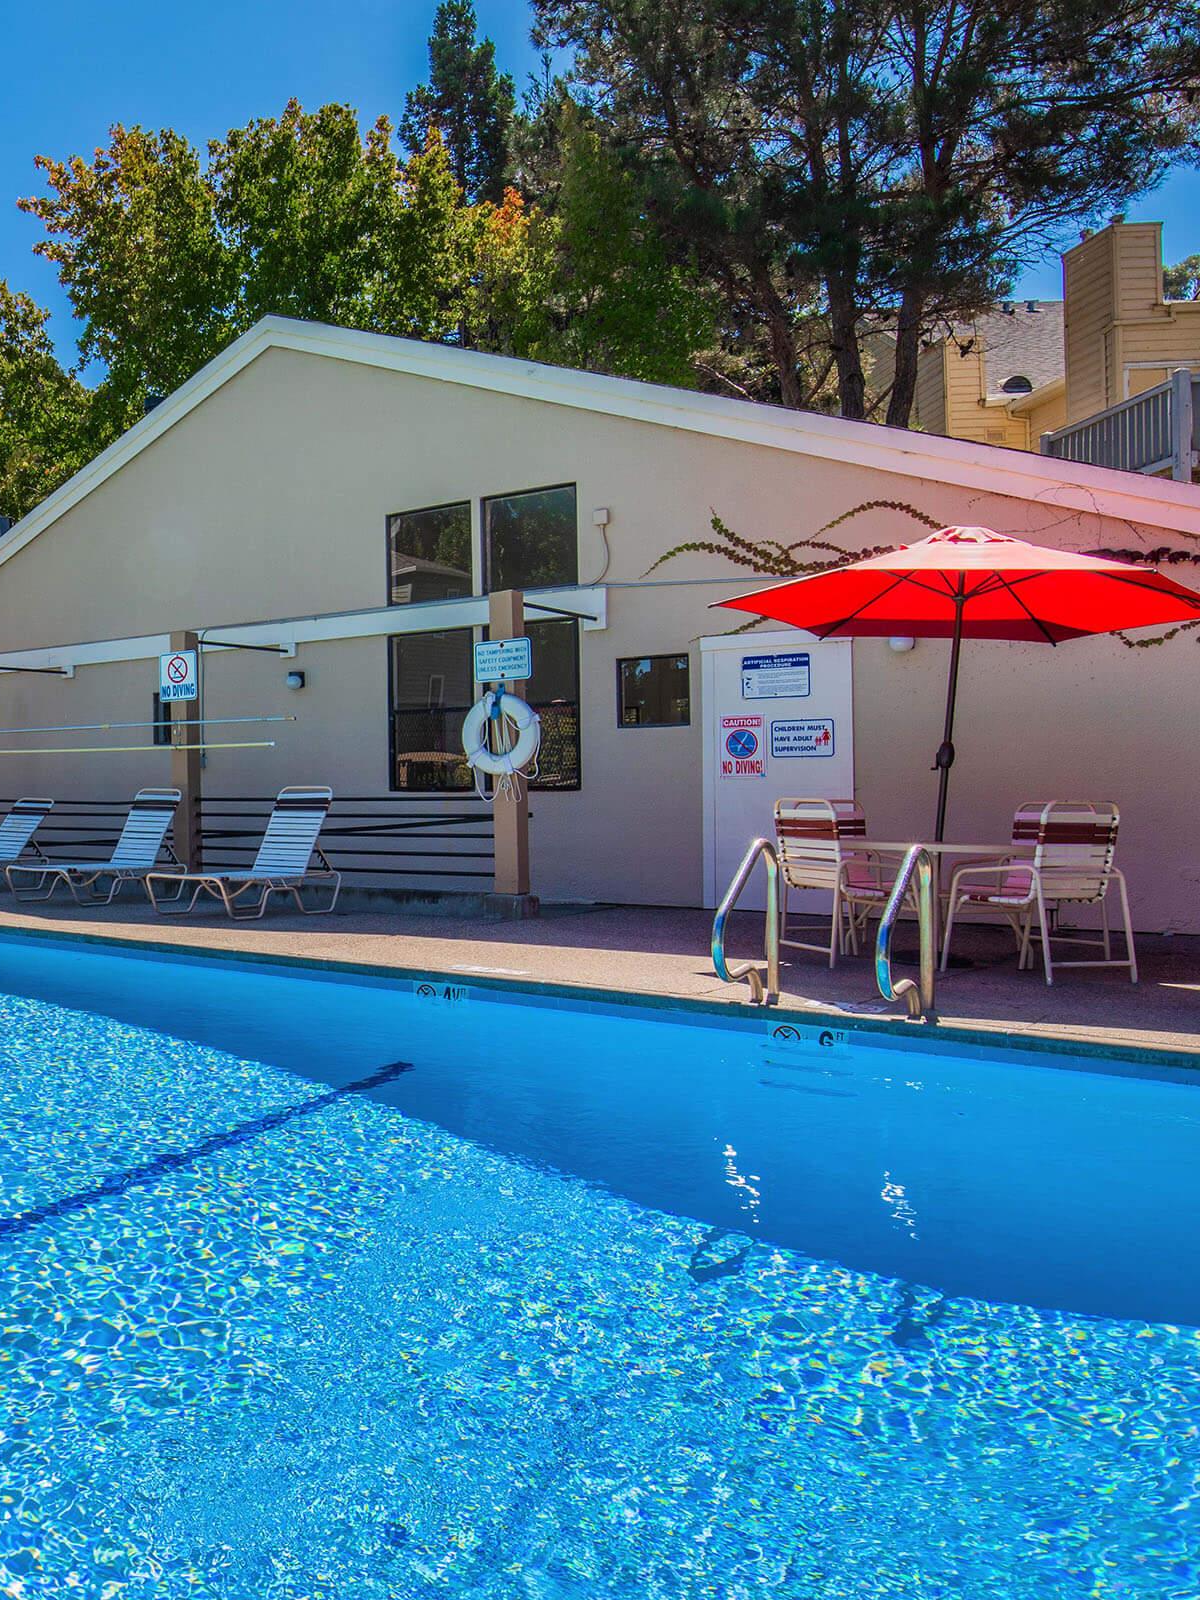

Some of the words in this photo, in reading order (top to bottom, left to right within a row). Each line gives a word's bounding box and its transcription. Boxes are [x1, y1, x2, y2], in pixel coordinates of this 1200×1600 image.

[486, 648, 513, 656] TAMPERING
[161, 685, 171, 698] NO
[172, 683, 195, 697] DIVING
[723, 718, 761, 727] CAUTION!
[722, 760, 733, 774] NO
[735, 760, 763, 774] DIVING!
[836, 1031, 845, 1041] FT
